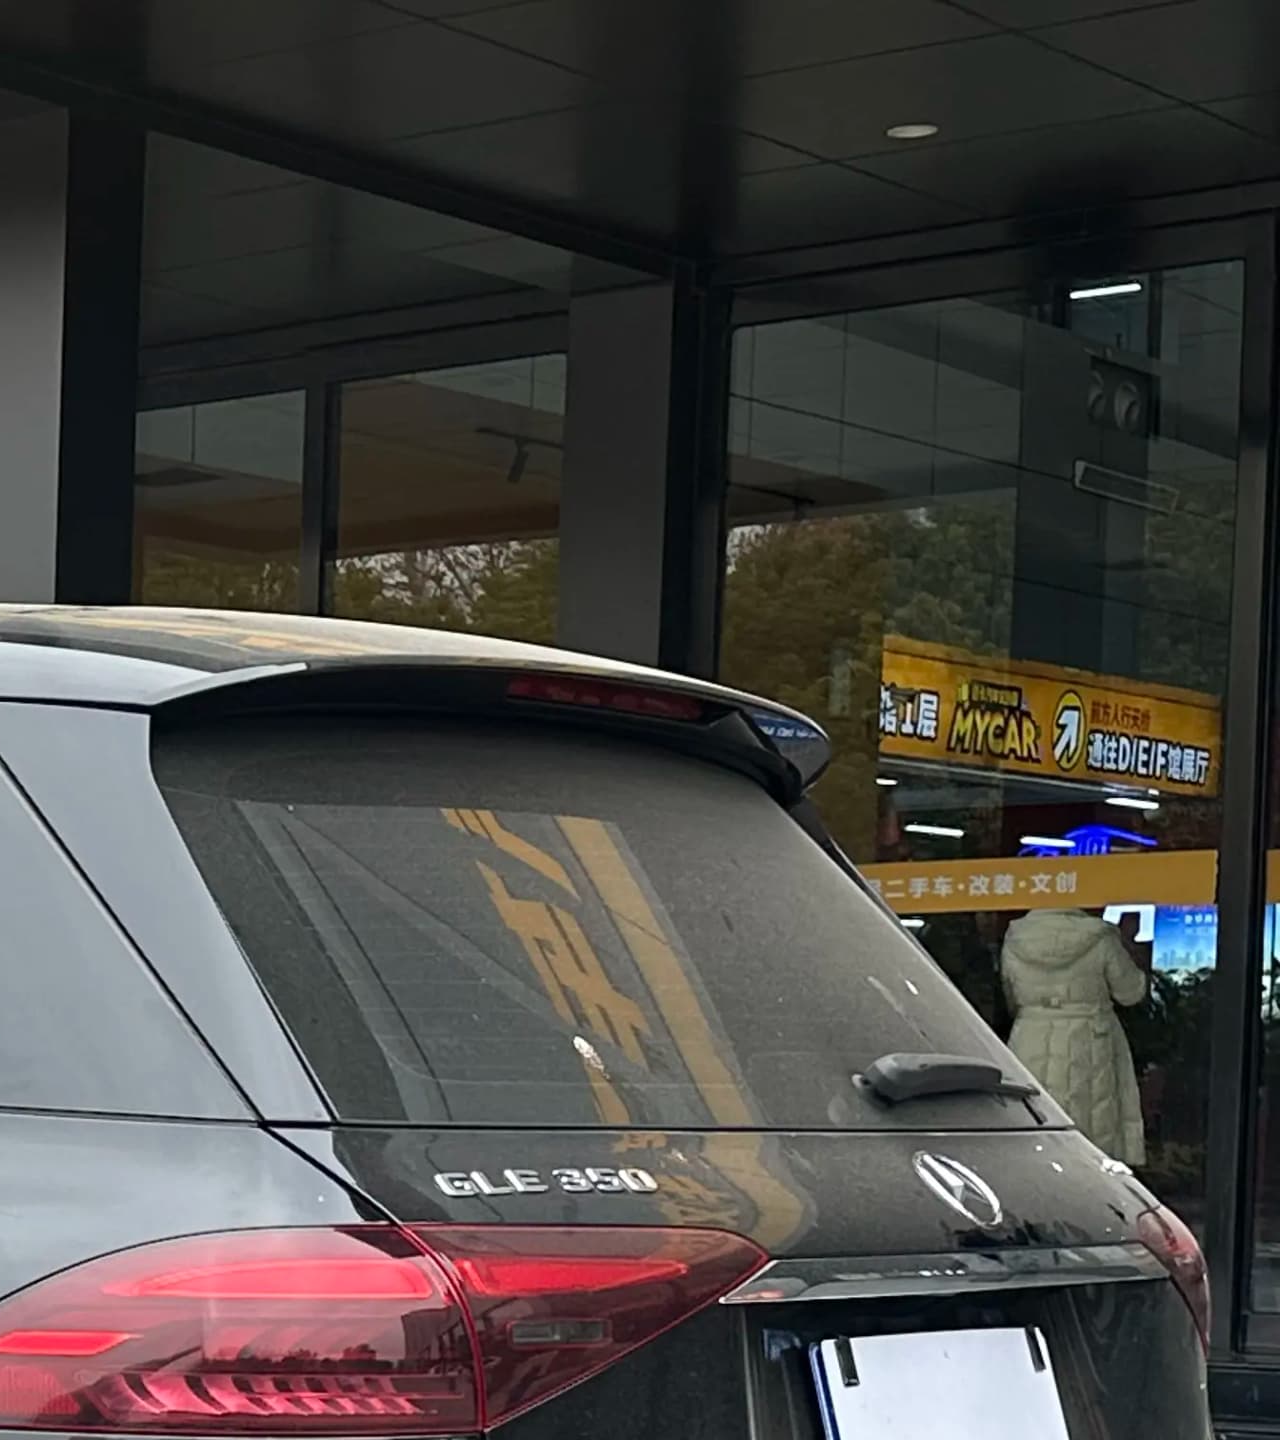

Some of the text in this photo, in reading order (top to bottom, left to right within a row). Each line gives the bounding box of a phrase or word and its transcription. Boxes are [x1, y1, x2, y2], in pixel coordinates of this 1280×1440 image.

[949, 702, 1040, 763] MYCAR
[434, 1167, 659, 1197] GLE 350
